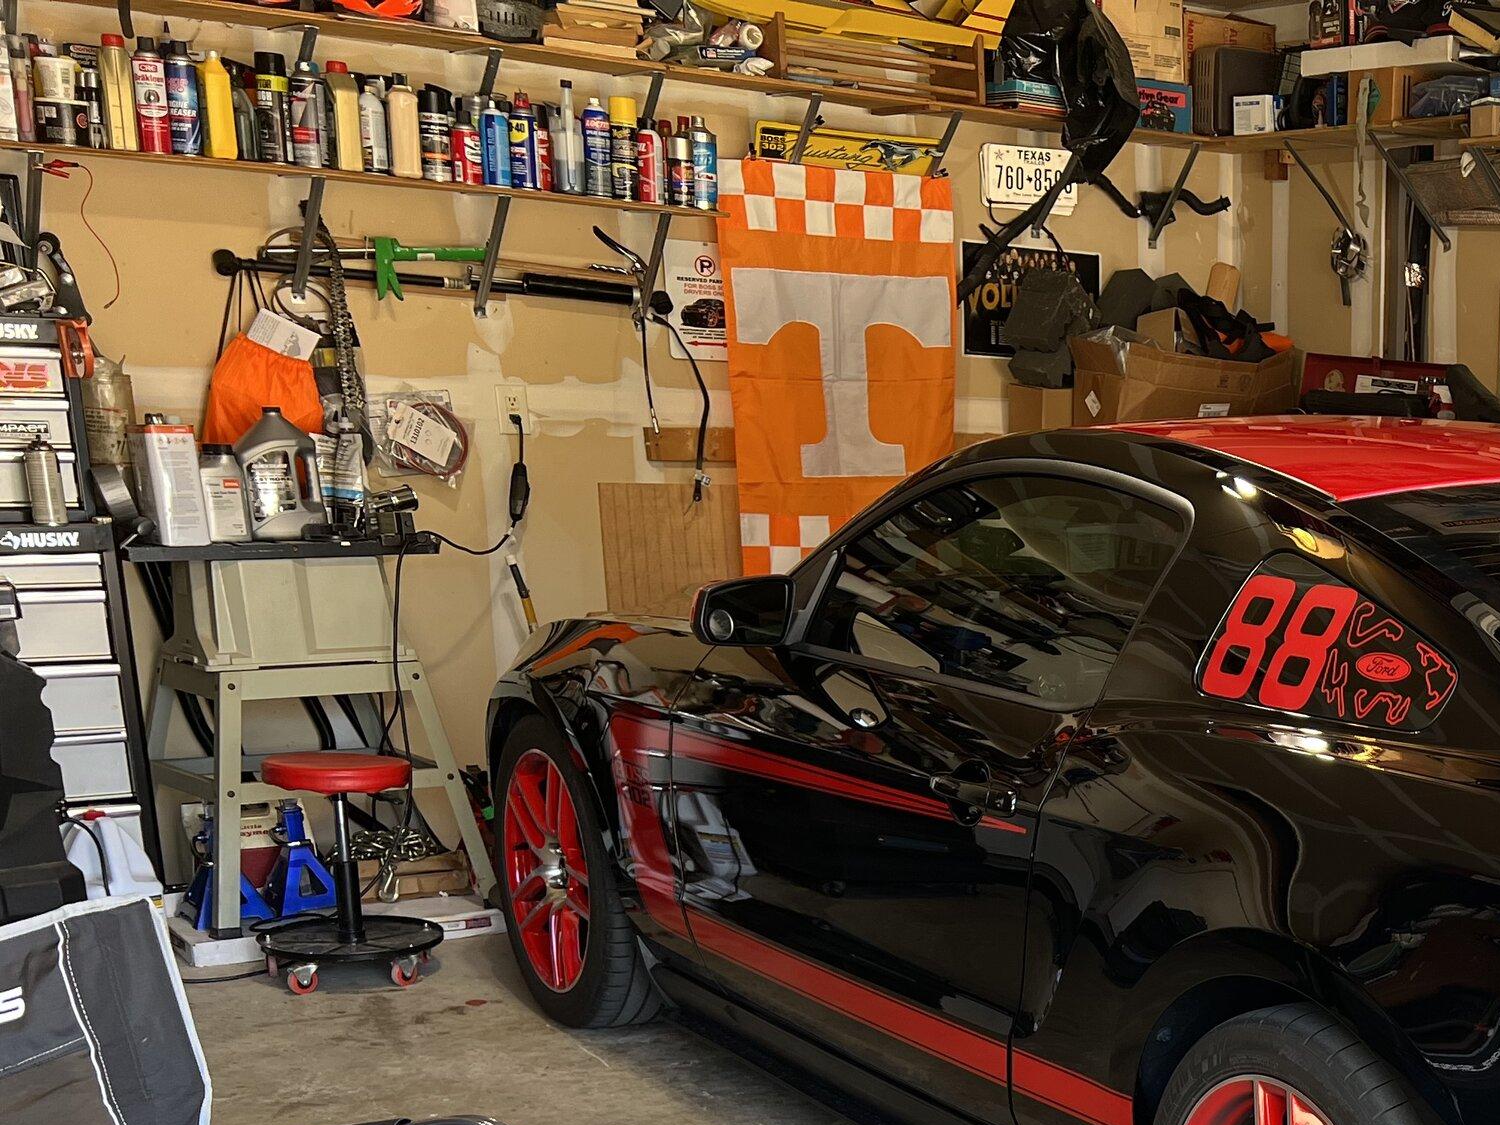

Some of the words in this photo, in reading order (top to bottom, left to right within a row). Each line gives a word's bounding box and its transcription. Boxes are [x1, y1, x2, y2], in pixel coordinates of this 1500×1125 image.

[760, 134, 786, 143] BOSS
[761, 142, 785, 151] 302
[1017, 149, 1051, 162] TEXAS
[995, 164, 1023, 190] 760
[676, 276, 708, 284] RESERVED
[20, 531, 80, 548] HUSKY
[1202, 574, 1359, 710] 88
